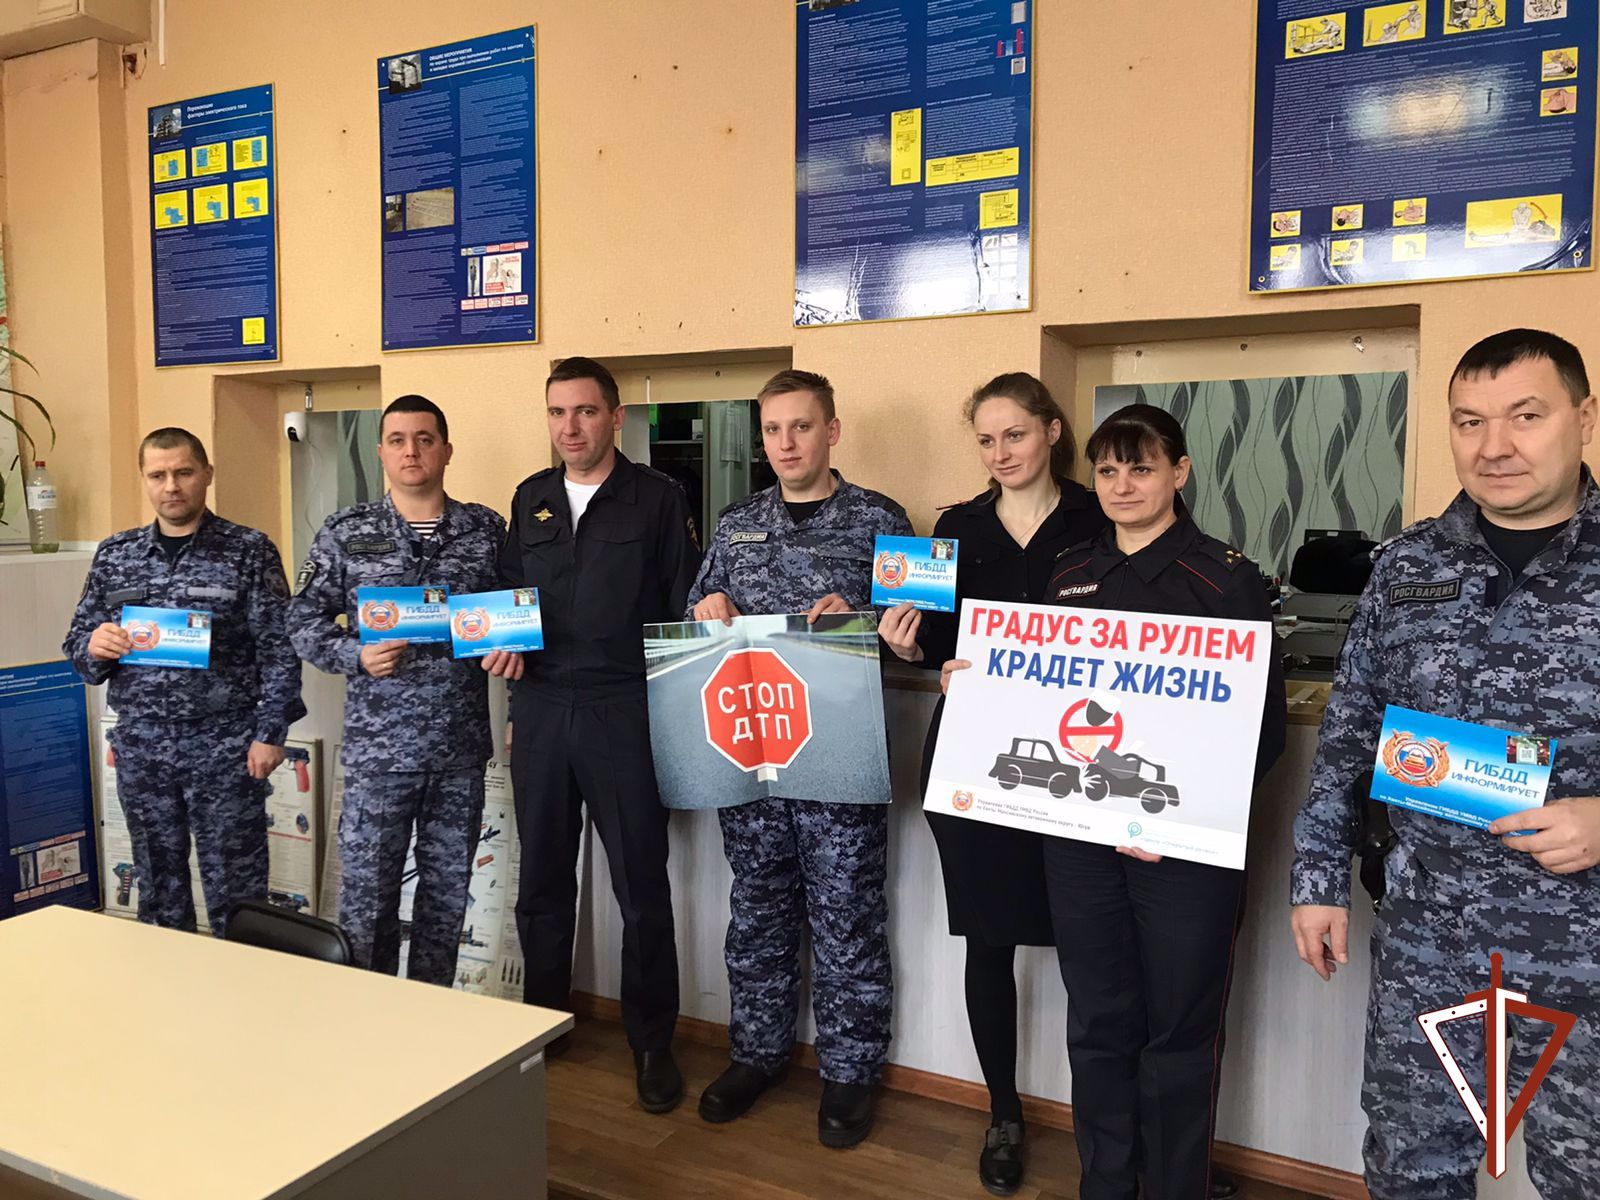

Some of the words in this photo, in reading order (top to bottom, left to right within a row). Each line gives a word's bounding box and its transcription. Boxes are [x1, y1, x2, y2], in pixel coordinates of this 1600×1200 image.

[914, 561, 947, 574] ГИБДД
[1058, 583, 1098, 597] РОСГВАРДИЯ
[1393, 584, 1455, 599] РОСГВАРДИЯ
[406, 605, 440, 614] ГИБДД
[497, 609, 531, 619] ГИБДД
[168, 628, 201, 638] ГИБДД
[970, 607, 1084, 647] ГРАДУС
[1089, 617, 1129, 651] ЗА
[1138, 621, 1257, 663] РУЛЕМ
[986, 647, 1105, 689] КРАДЕТ
[1109, 660, 1232, 704] ЖИЗНЬ
[717, 681, 796, 714] СТОП
[732, 712, 793, 745] ДТП
[1463, 758, 1529, 786] ГИБДД
[1451, 771, 1540, 799] ИНФОРМИРУЕТ
